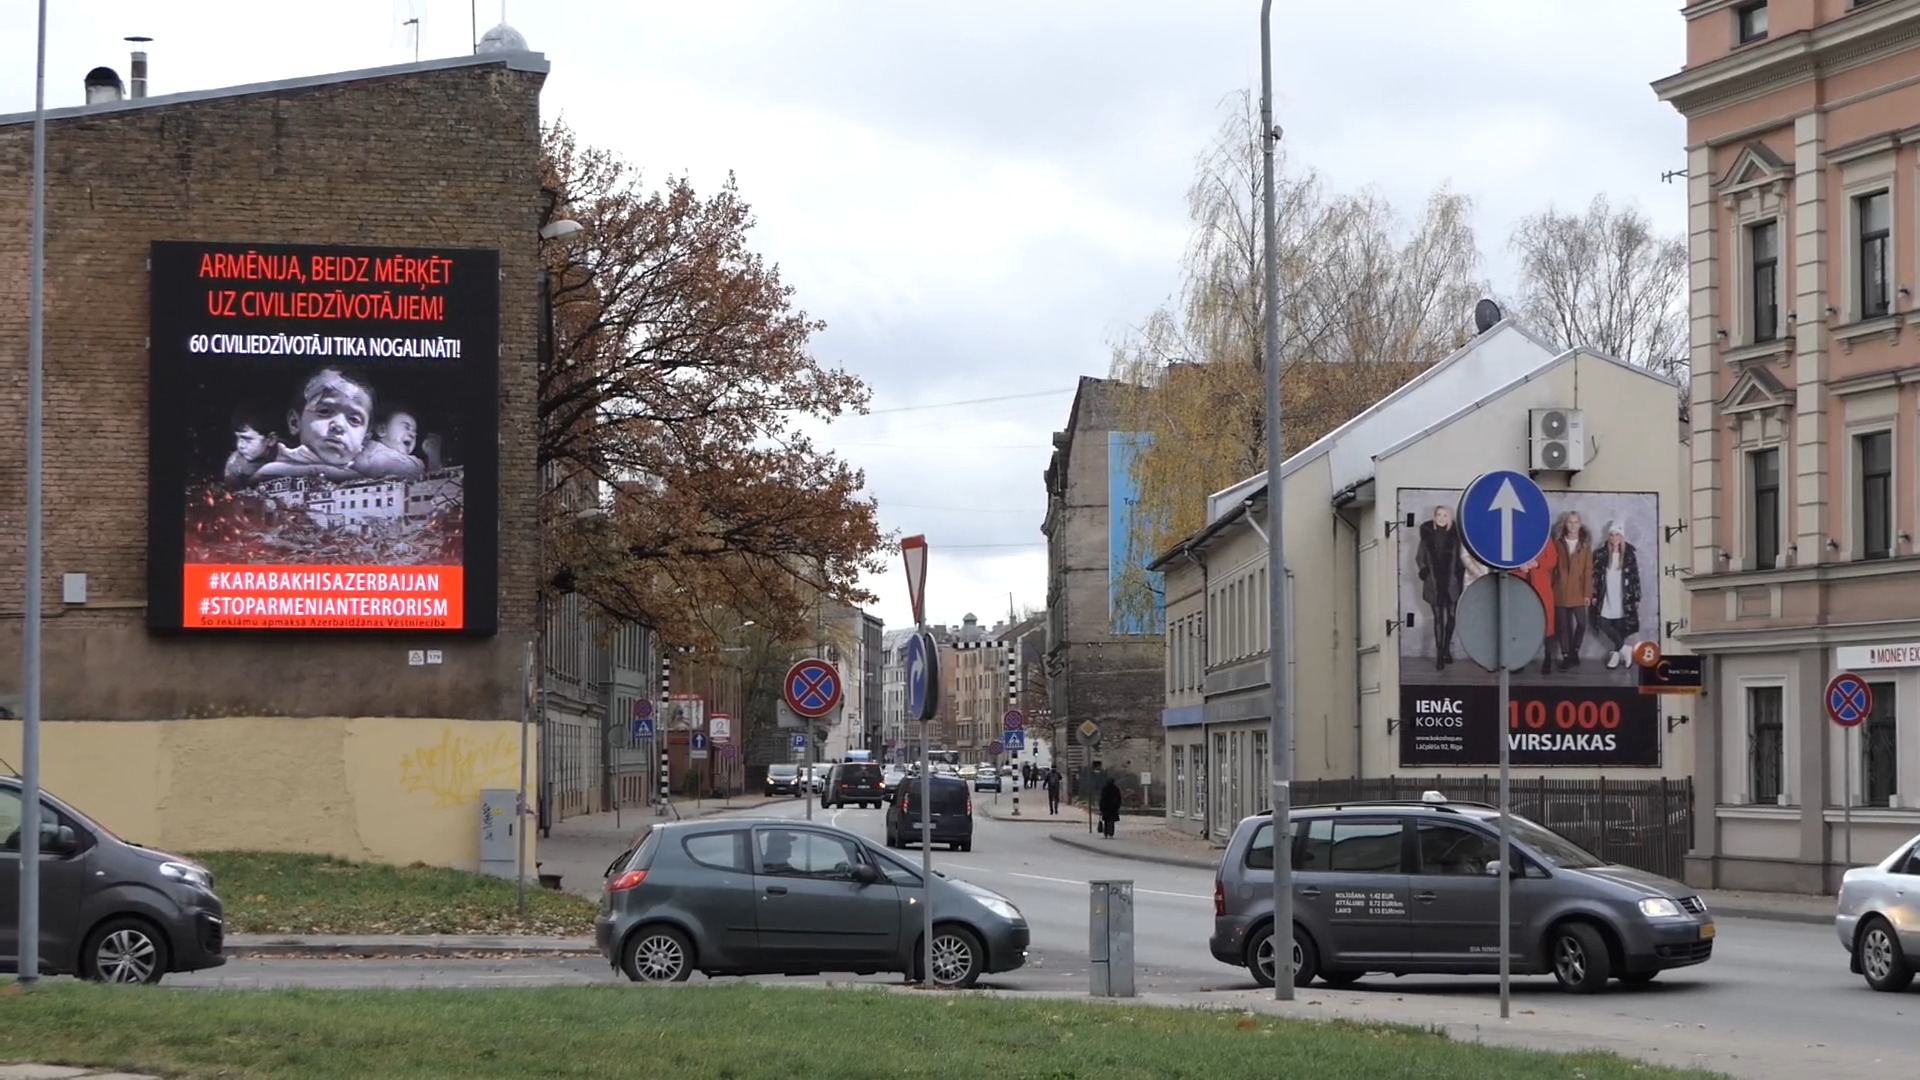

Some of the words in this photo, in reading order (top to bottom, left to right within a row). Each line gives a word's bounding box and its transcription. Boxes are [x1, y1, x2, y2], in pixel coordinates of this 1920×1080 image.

[199, 250, 306, 284] ARMĒNIJA,
[312, 256, 369, 283] BEIDZ
[374, 254, 453, 290] MĒRĶĒT
[208, 290, 237, 316] UZ
[241, 289, 444, 321] CIVILIEDZĪVOTĀJIEM!
[190, 334, 209, 353] 60
[211, 332, 332, 356] CIVILIEDZĪVOTĀJI
[333, 337, 367, 357] TIKA
[369, 336, 461, 359] NOGALINĀTI!
[209, 571, 440, 592] #KARABAKHISAZERBAIJAN
[199, 596, 448, 616] #STOPARMENIANTERRORISM
[1877, 647, 1907, 663] MONEY
[1415, 697, 1463, 714] IENĀC
[1508, 700, 1546, 729] 10
[1555, 700, 1621, 729] 000
[1415, 716, 1463, 727] KOKOS
[1508, 733, 1617, 751] VIRSJAKAS
